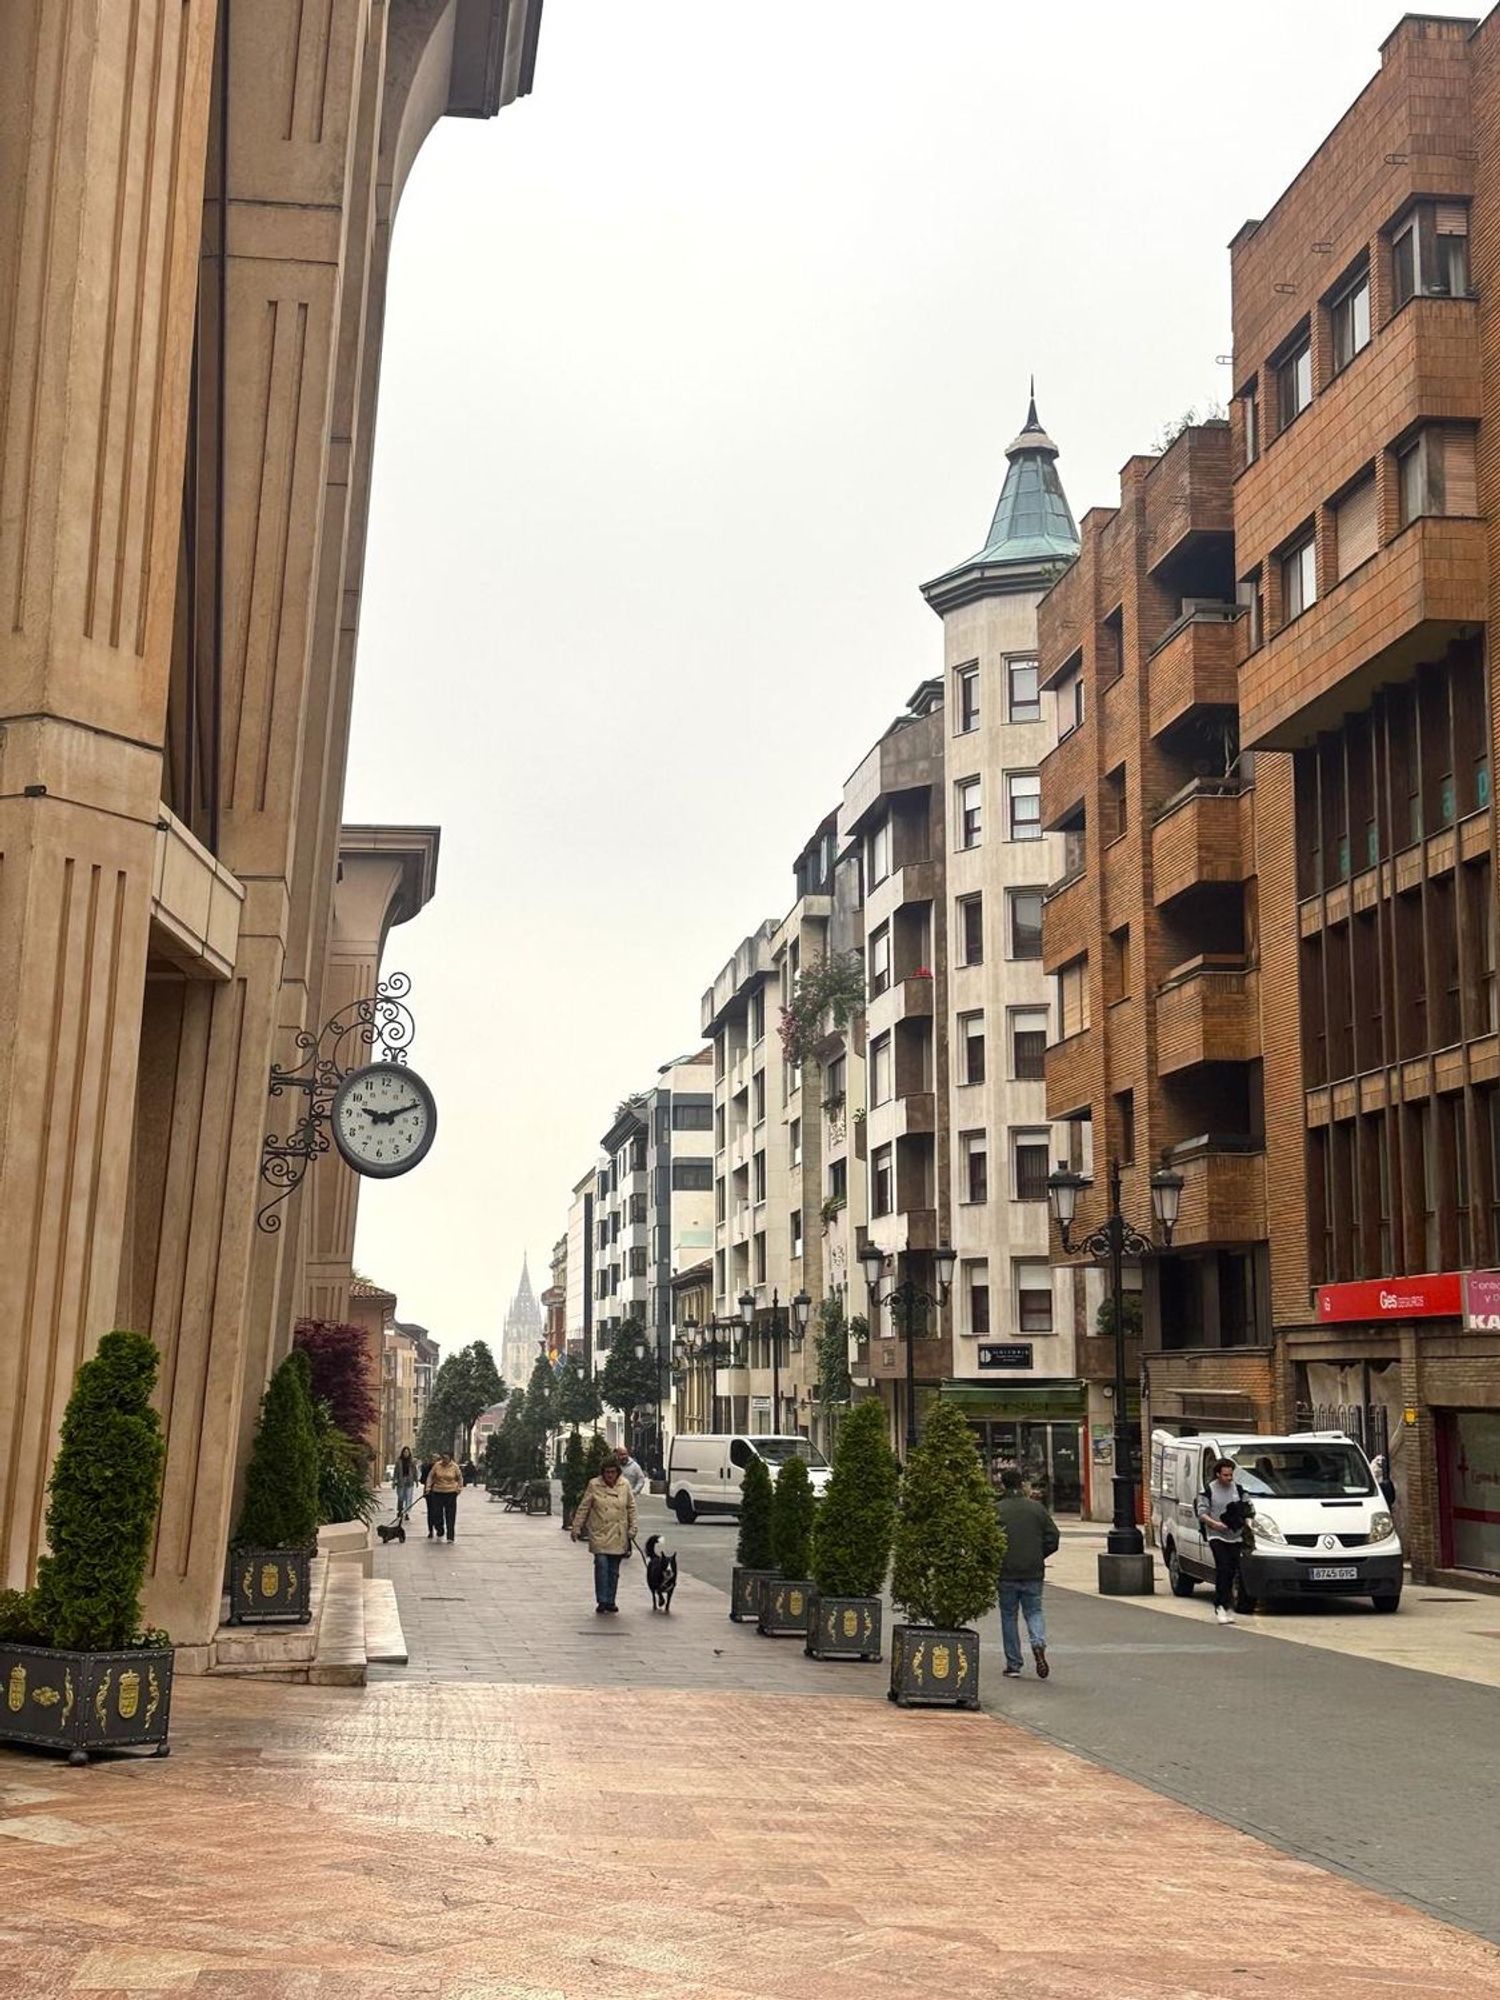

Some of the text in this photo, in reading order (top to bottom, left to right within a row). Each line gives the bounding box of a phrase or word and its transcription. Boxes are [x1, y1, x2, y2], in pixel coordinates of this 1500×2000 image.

[365, 1081, 373, 1090] 11
[381, 1077, 392, 1087] 12
[353, 1093, 362, 1102] 10
